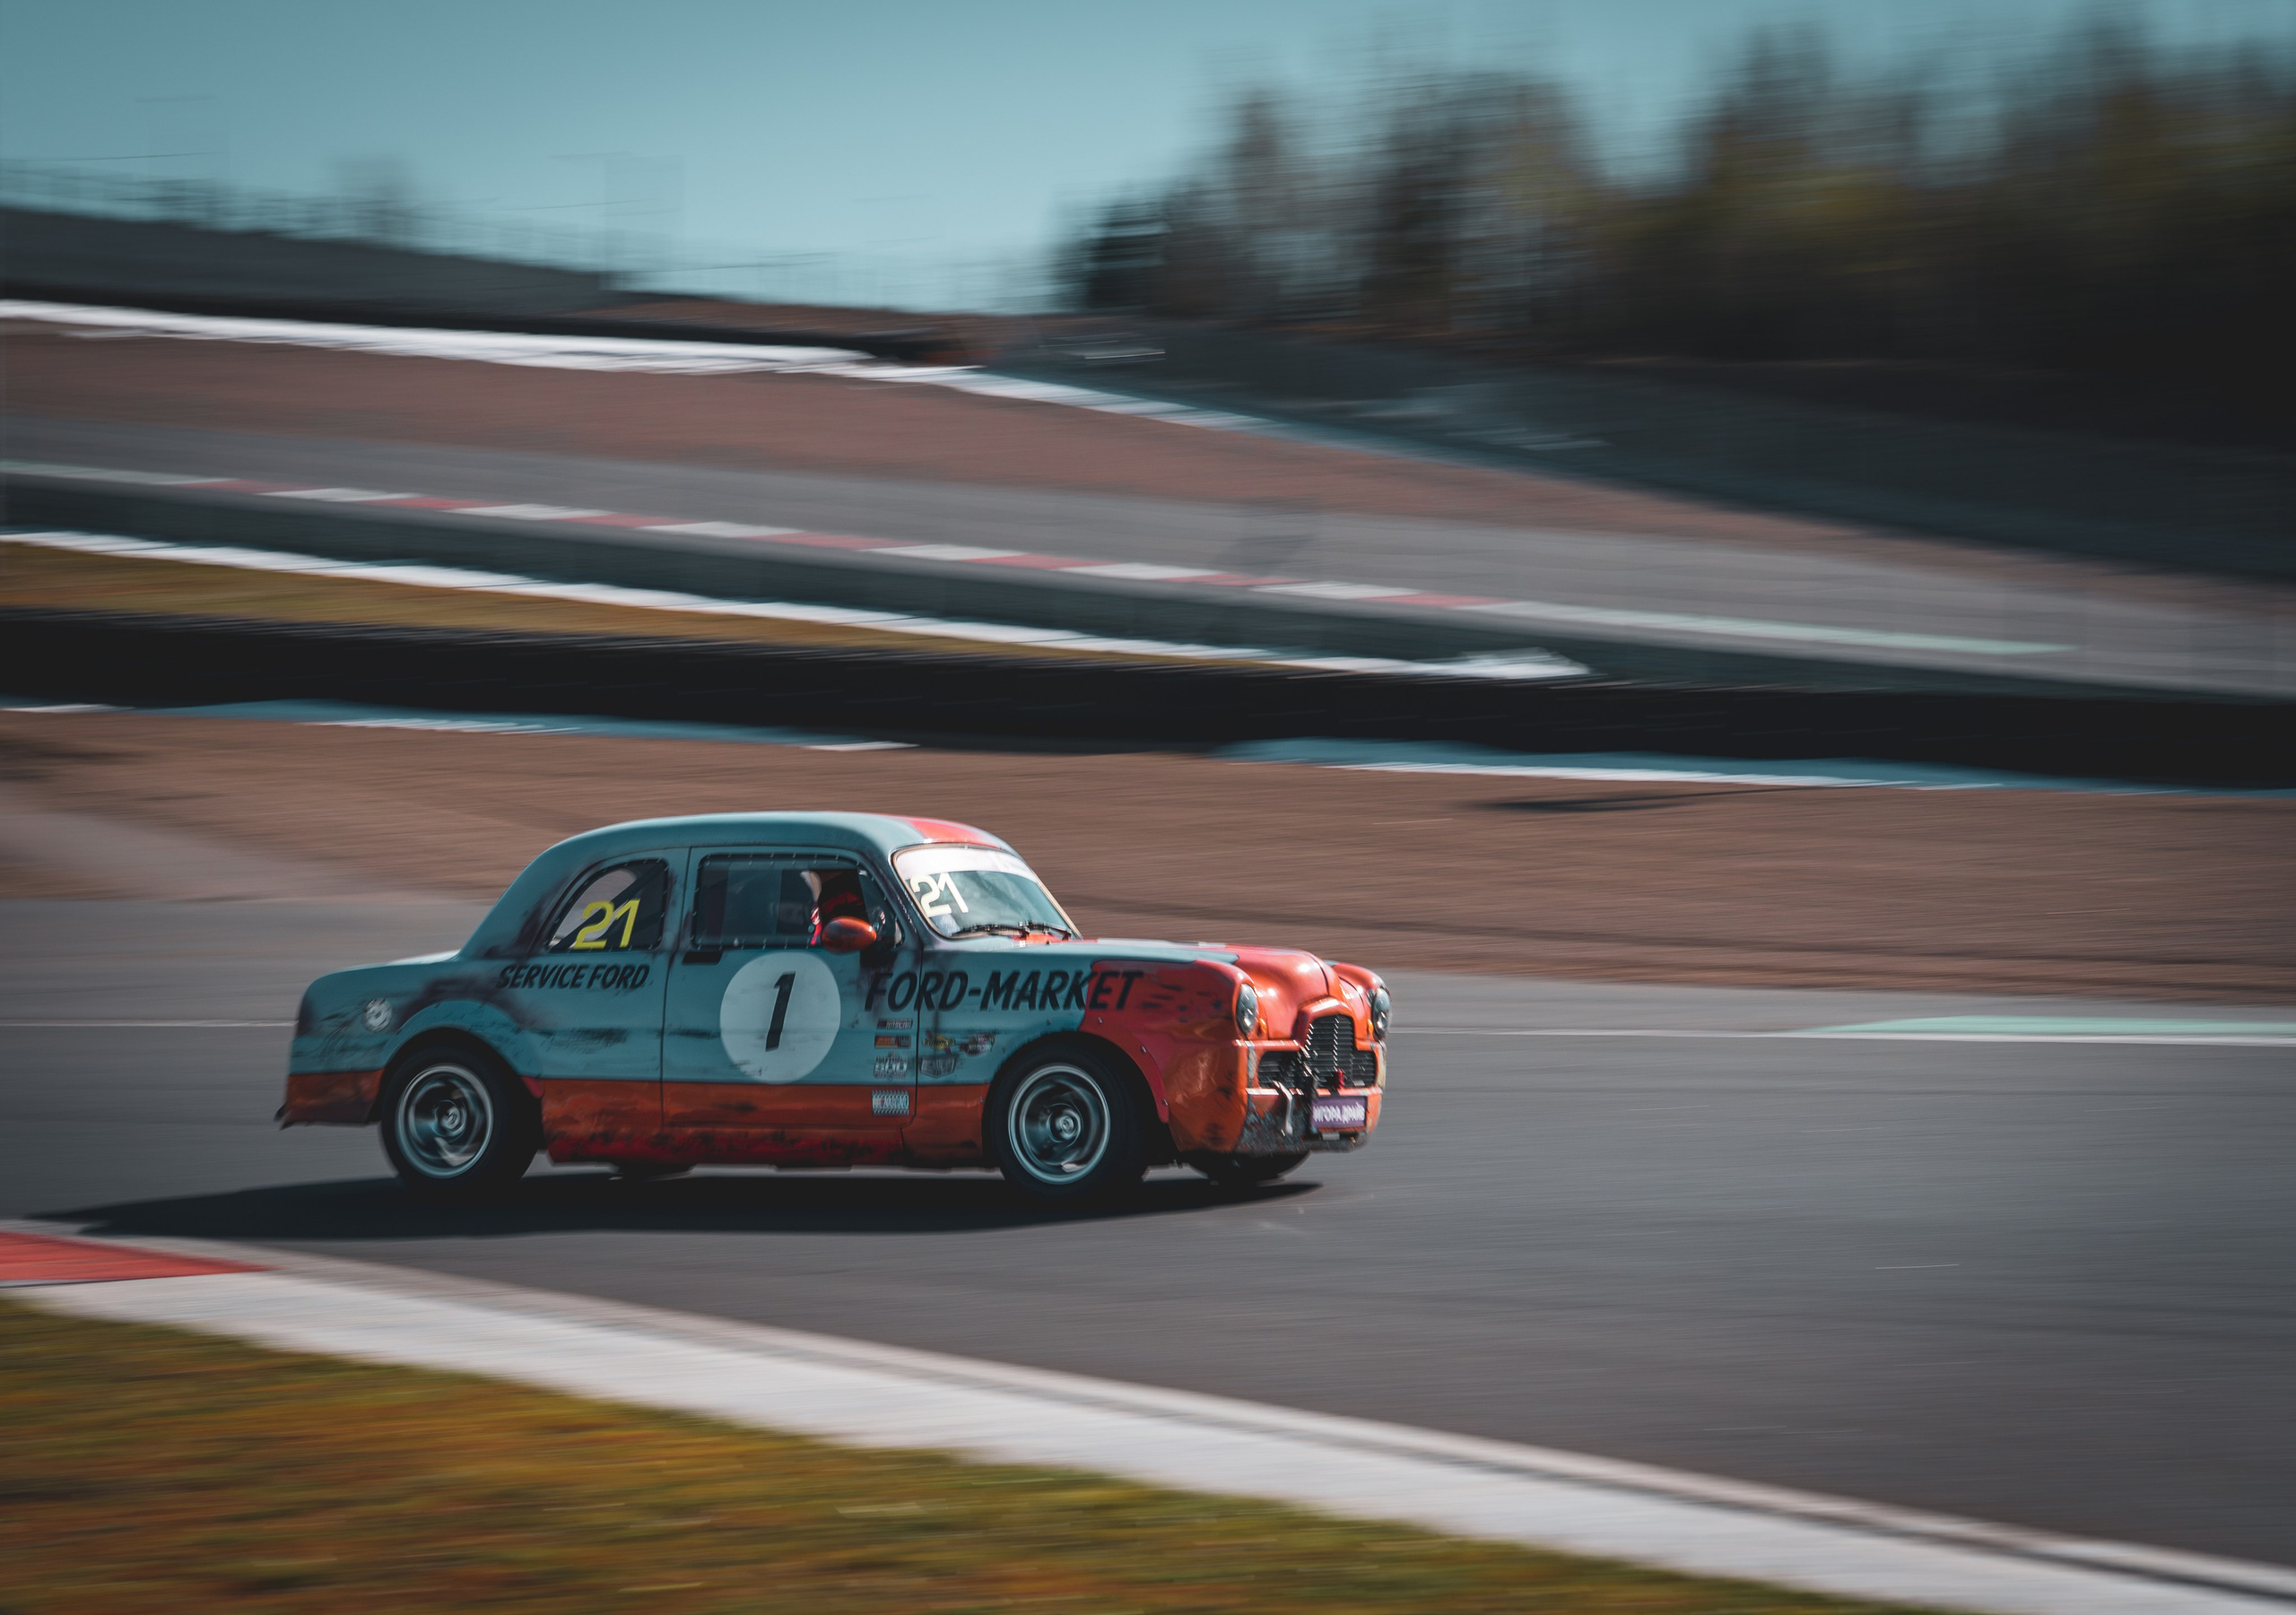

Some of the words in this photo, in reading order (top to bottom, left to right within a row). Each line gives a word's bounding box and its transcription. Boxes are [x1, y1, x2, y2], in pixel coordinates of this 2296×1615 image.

[909, 873, 969, 918] 21
[573, 899, 640, 950] 21
[498, 963, 588, 989] SERVICE
[587, 963, 650, 989] FORD
[865, 970, 1144, 1011] FORD-MARKET
[765, 971, 796, 1052] 1
